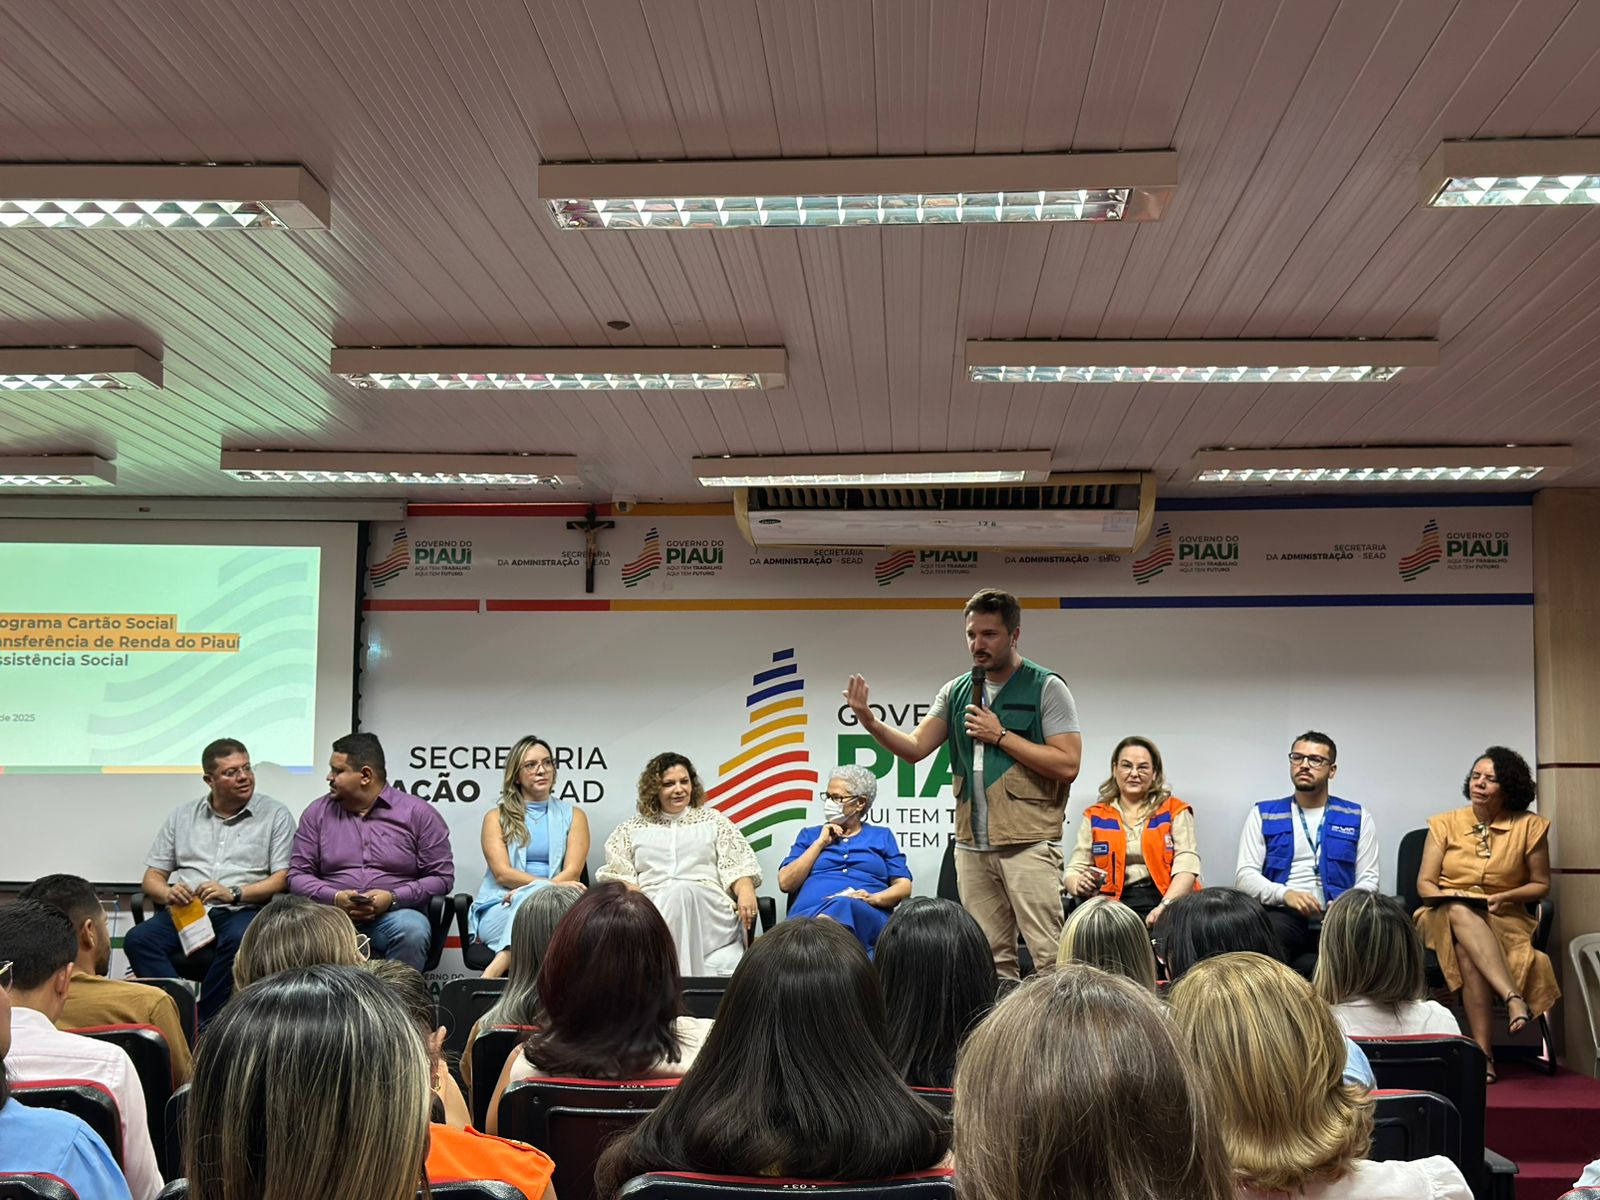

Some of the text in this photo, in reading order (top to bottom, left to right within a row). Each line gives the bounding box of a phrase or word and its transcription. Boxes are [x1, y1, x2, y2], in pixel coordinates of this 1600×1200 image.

[1179, 535, 1223, 543] GOVERNO
[511, 557, 580, 568] ADMINISTRAÇÃO
[763, 556, 832, 566] ADMINISTRAÇÃO
[1019, 554, 1089, 564] ADMINISTRAÇÃO
[1280, 551, 1353, 562] ADMINISTRAÇÃO
[67, 616, 121, 629] Cartão
[125, 617, 173, 630] Social
[0, 635, 241, 649] nsferência de Renda do Piauí
[80, 653, 129, 666] Social
[12, 713, 36, 722] 2025
[409, 746, 608, 769] SECRERIA
[895, 808, 940, 823] TEM
[895, 831, 940, 848] TEM
